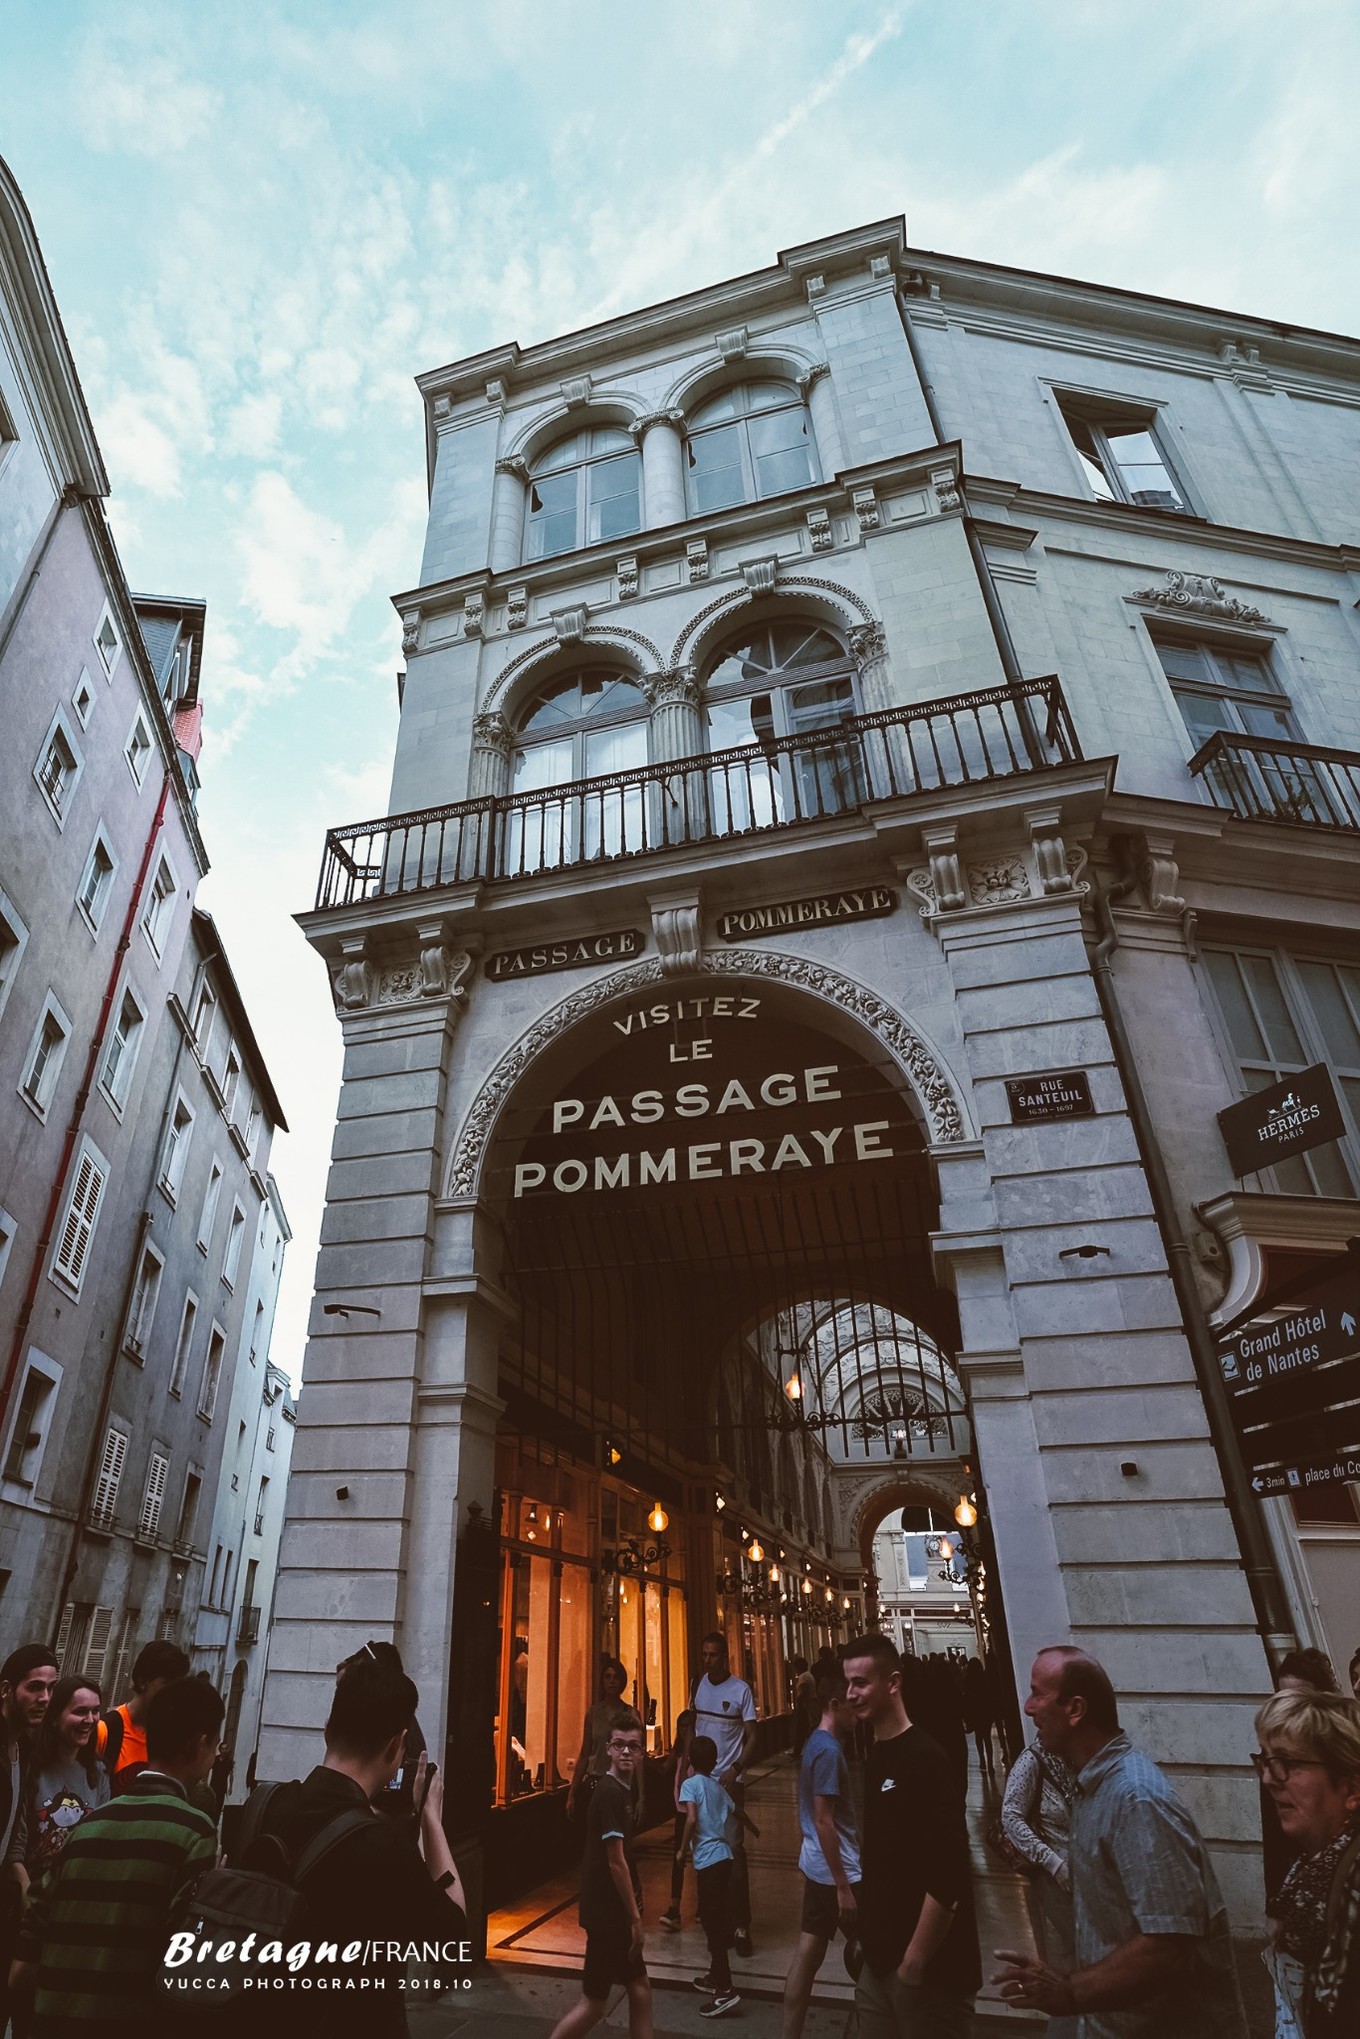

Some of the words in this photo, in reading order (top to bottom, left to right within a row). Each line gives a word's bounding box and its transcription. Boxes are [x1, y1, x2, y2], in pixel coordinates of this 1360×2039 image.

[723, 888, 892, 937] POMMERAYE
[494, 932, 636, 977] PASSAGE
[613, 997, 761, 1037] VISITEZ
[669, 1039, 713, 1064] LE
[552, 1065, 842, 1134] PASSAGE
[1018, 1089, 1083, 1107] SANTEUIL
[1040, 1079, 1064, 1092] RUE
[1277, 1126, 1304, 1144] PARIS
[514, 1121, 894, 1198] POMMERAYE
[1240, 1327, 1281, 1359] Grand
[1285, 1308, 1327, 1342] Hôtel
[1246, 1362, 1263, 1383] de
[1267, 1343, 1320, 1375] Nantes
[1333, 1463, 1345, 1478] du
